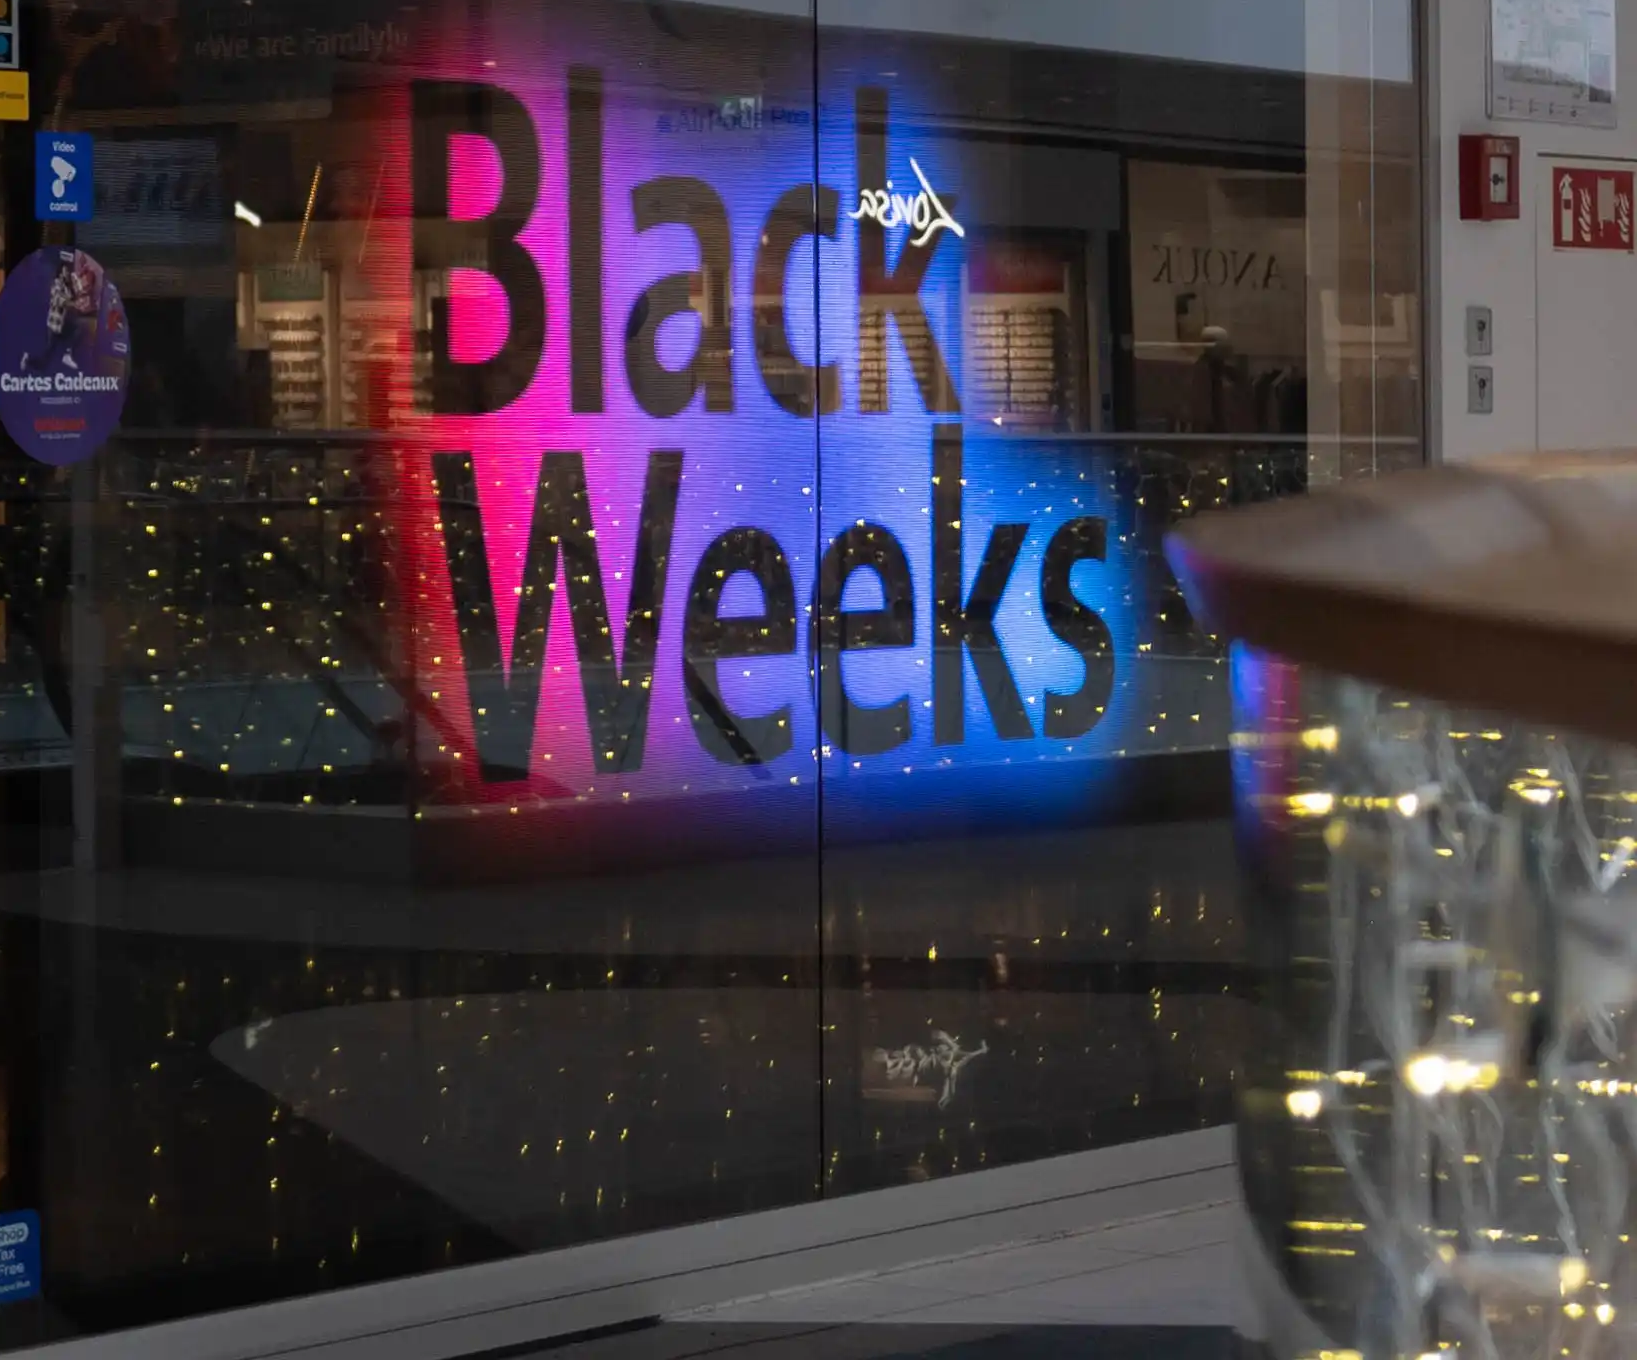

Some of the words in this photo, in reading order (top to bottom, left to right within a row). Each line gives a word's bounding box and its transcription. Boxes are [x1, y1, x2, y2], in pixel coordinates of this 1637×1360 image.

[51, 141, 77, 153] Video
[409, 63, 964, 418] Black
[0, 372, 53, 393] Cartes
[53, 370, 120, 392] Cadeaux
[429, 423, 1115, 783] Weeks
